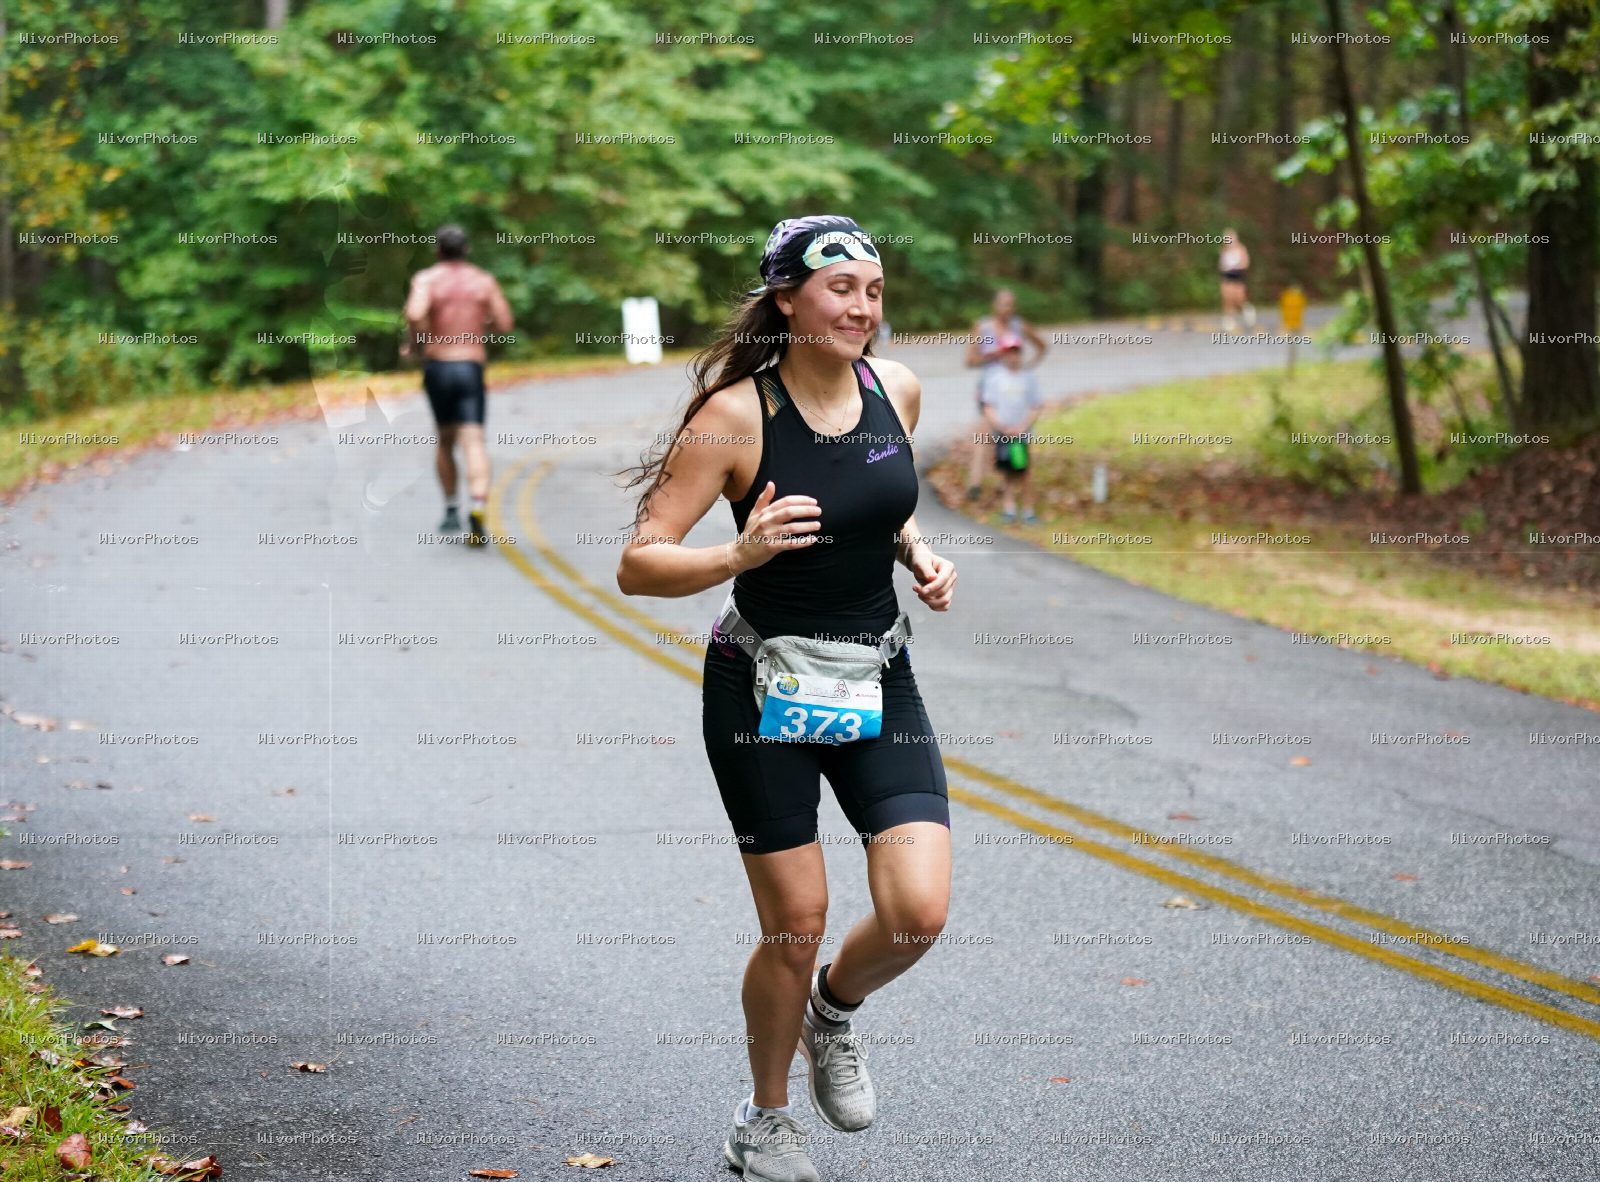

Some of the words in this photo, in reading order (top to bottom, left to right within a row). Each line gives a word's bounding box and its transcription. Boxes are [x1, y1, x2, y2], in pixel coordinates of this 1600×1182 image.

[866, 443, 898, 463] Santic
[781, 707, 863, 743] 373
[820, 1005, 840, 1019] 373
